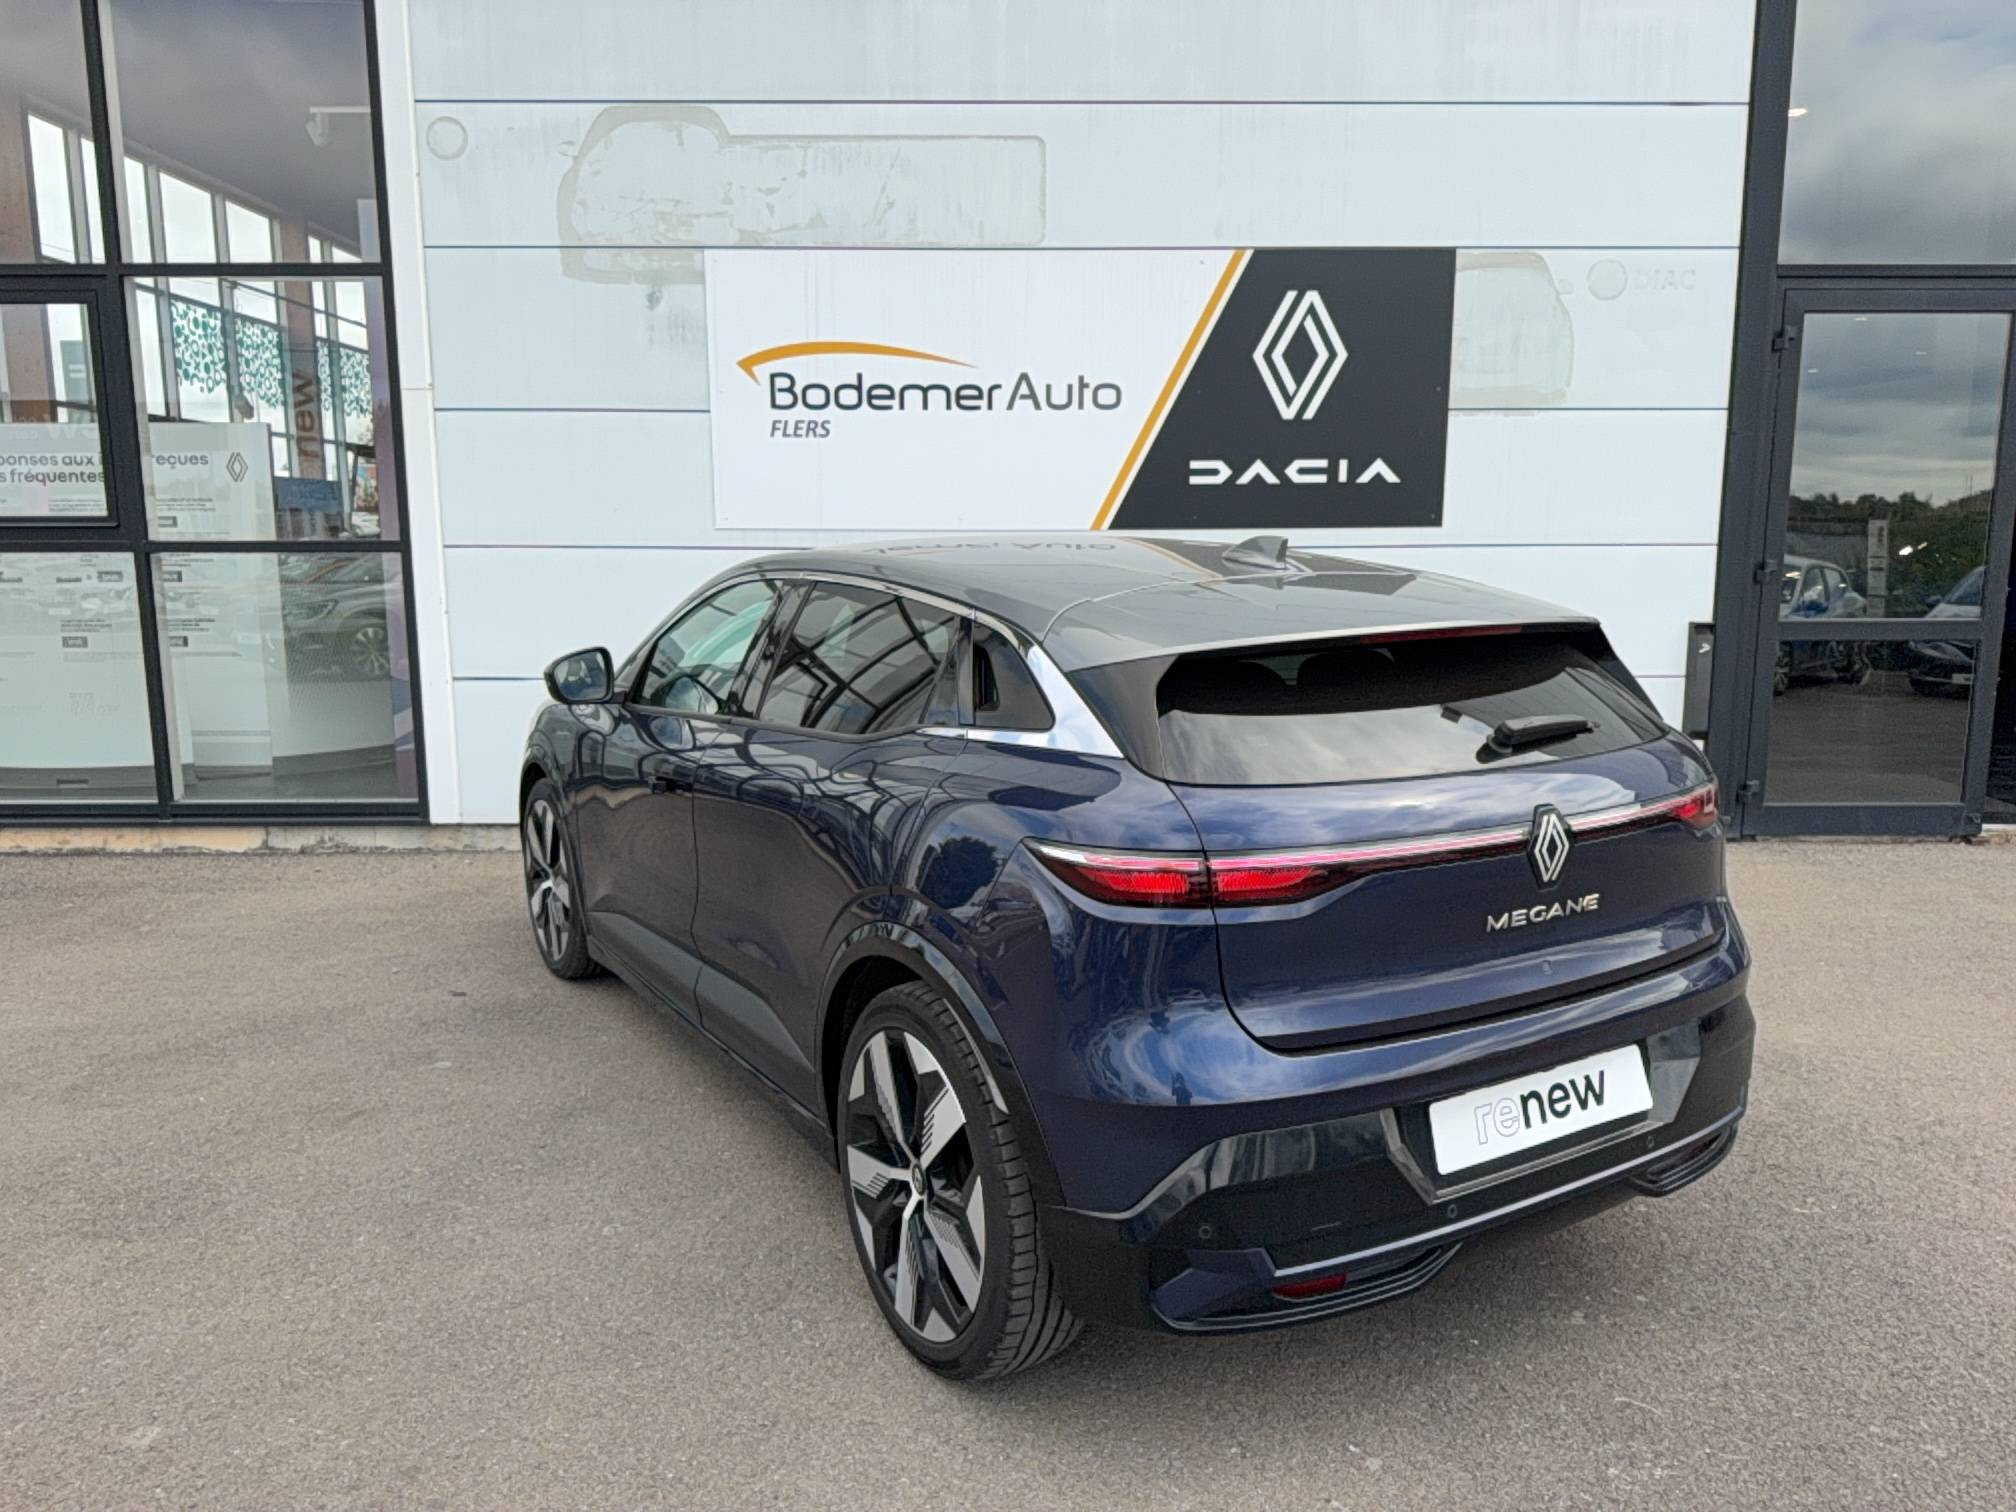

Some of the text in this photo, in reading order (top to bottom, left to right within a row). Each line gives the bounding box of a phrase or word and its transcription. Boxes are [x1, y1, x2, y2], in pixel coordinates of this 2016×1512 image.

[770, 419, 832, 438] FLERS
[62, 455, 95, 467] aux
[1188, 457, 1402, 486] DACIA
[1486, 892, 1600, 933] MEGANE
[1474, 1069, 1606, 1145] renew
